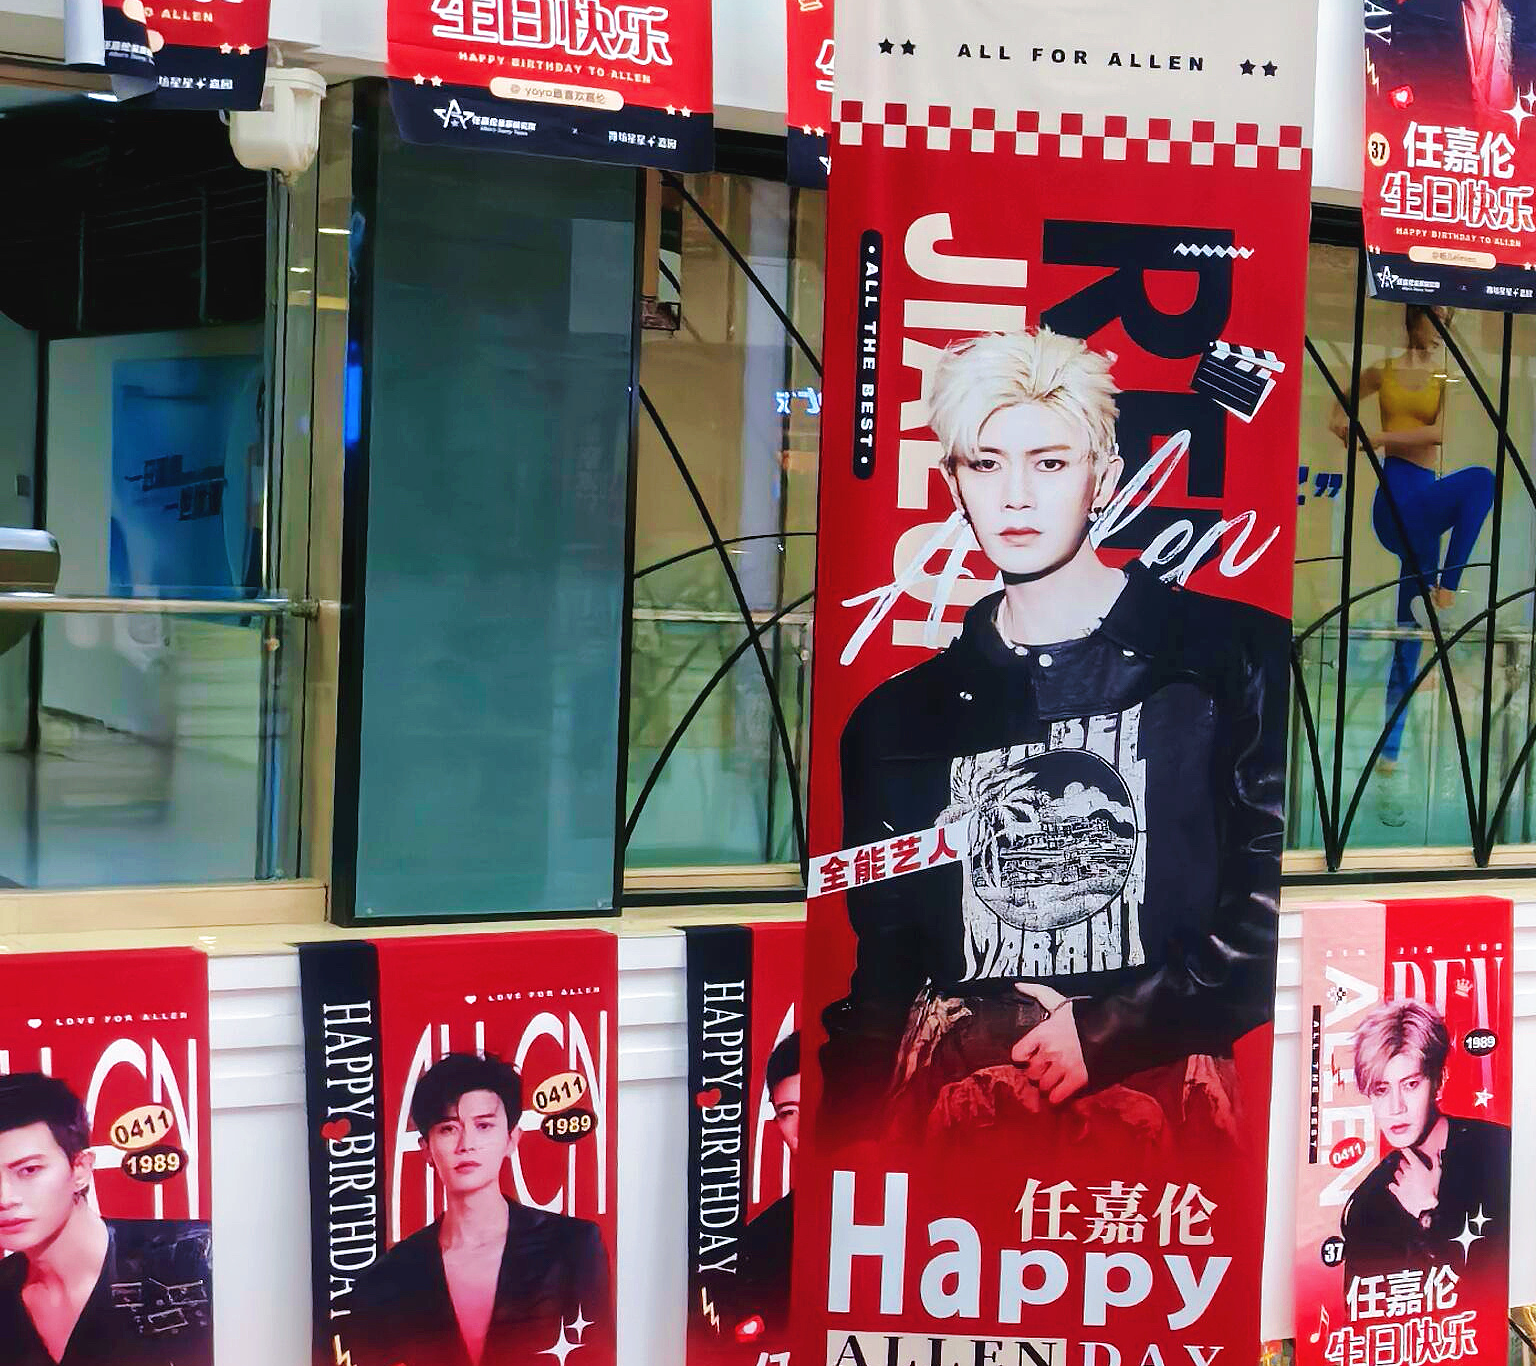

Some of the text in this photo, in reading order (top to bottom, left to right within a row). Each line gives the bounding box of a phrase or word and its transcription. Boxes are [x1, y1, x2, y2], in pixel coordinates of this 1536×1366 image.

[458, 51, 651, 84] HAPPY BIRTHDAY TO ALLEN
[957, 43, 1205, 72] ALL FOR ALLEN
[1370, 140, 1387, 161] 37
[1403, 121, 1516, 173] 任嘉伦
[1379, 171, 1535, 233] 生日快乐
[860, 260, 880, 450] ALL THE BEST
[819, 826, 959, 894] 全能艺人
[1466, 1034, 1496, 1051] 1989
[535, 1077, 585, 1110] 0411
[114, 1110, 172, 1143] 0411
[545, 1114, 592, 1136] 1989
[698, 979, 745, 1277] HAPPY BIRTHDAY
[126, 1152, 181, 1176] 1989
[1332, 1143, 1364, 1166] 0411
[1015, 1177, 1218, 1247] 任嘉伦
[827, 1170, 1232, 1331] Happy
[1323, 1242, 1343, 1263] 37
[1347, 1265, 1461, 1322] 任嘉伦
